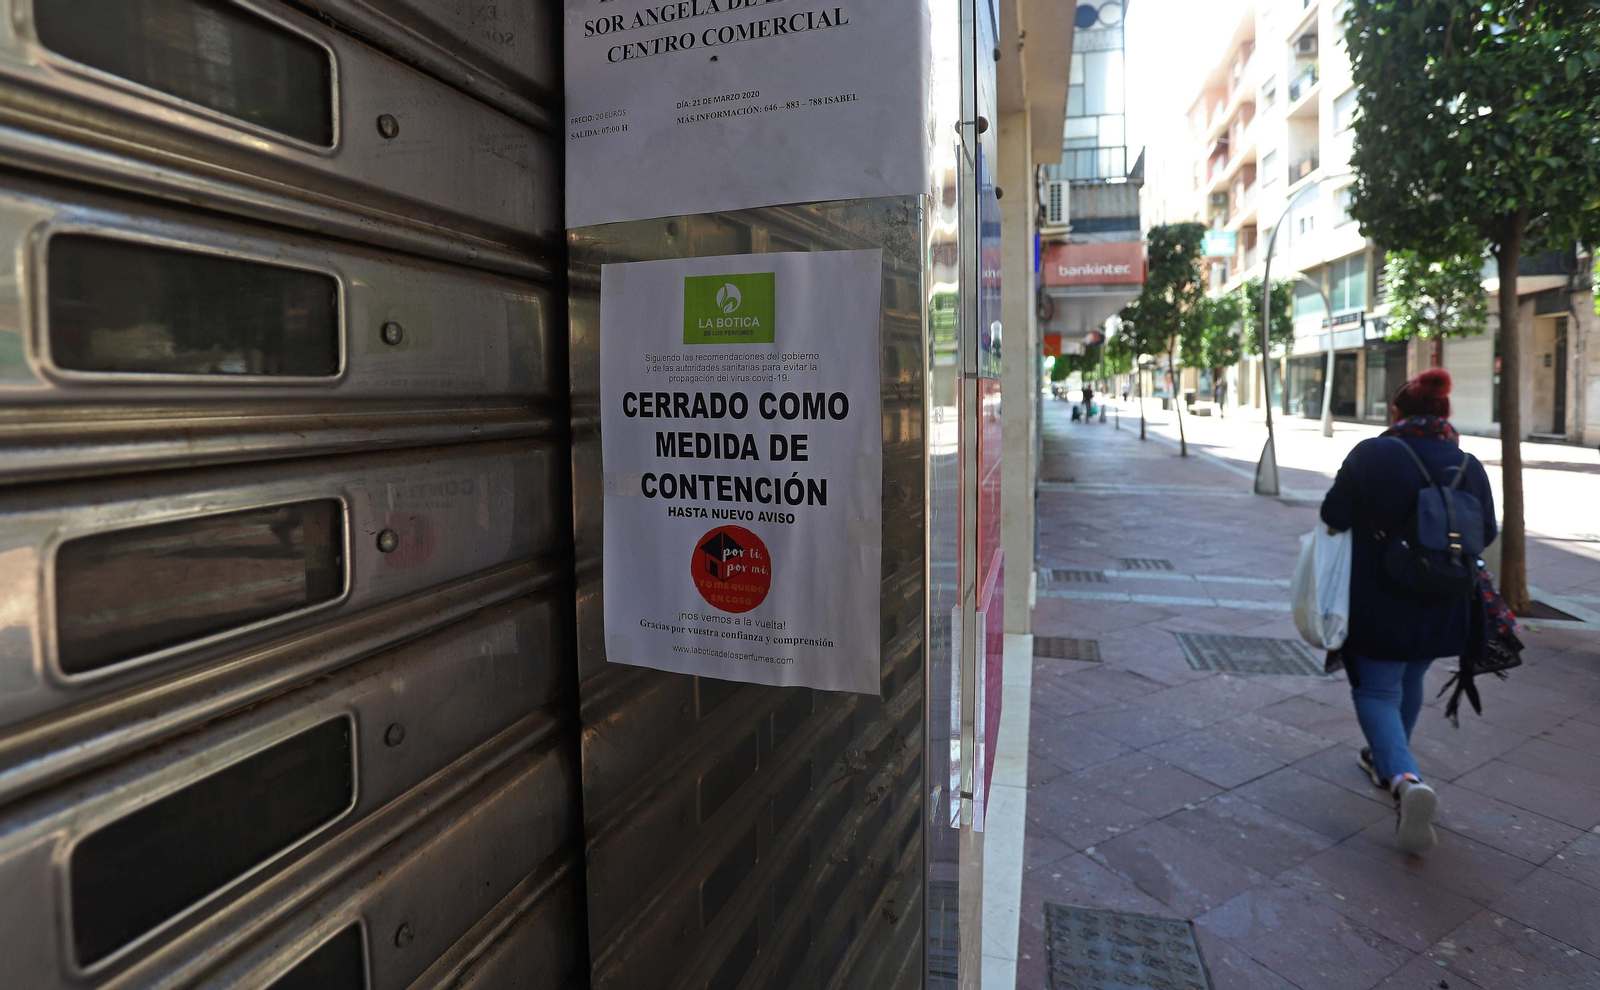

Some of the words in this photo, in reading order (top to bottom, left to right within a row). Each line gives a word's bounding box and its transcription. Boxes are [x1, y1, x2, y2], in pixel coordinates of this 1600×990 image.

[584, 15, 625, 38] SOR
[631, 0, 720, 28] ANGELA
[607, 32, 696, 63] CENTRO
[701, 7, 849, 47] COMERCIAL
[676, 100, 691, 109] DÍA:
[692, 99, 701, 107] 21
[702, 97, 712, 105] DE
[713, 93, 740, 103] MARZO
[742, 90, 760, 99] 2020
[676, 114, 695, 124] MÁS
[696, 105, 762, 122] INFORMACIÓN:
[764, 104, 778, 112] 646
[786, 101, 800, 109] 883
[808, 98, 822, 106] 788
[824, 93, 859, 105] ISABEL
[571, 115, 595, 125] PRECIO:
[596, 112, 604, 120] 20
[605, 109, 627, 119] EUROS
[571, 129, 600, 140] SALIDA:
[602, 125, 620, 134] 07:00
[622, 124, 629, 132] H
[698, 319, 713, 329] LA
[716, 316, 760, 328] BOTICA
[645, 354, 681, 364] Siguiendo
[682, 354, 694, 362] las
[695, 353, 765, 361] recomendaciones
[767, 352, 780, 360] del
[781, 352, 820, 362] gobierno
[652, 364, 662, 372] de
[663, 364, 674, 372] las
[675, 363, 720, 372] autoridades
[721, 363, 760, 371] sanitarias
[762, 364, 781, 372] para
[783, 362, 808, 371] evitar
[809, 362, 818, 371] la
[668, 374, 714, 383] propagación
[717, 374, 729, 382] del
[730, 374, 750, 382] virus
[751, 373, 790, 382] covid-19.
[622, 391, 749, 420] CERRADO
[759, 391, 850, 421] COMO
[655, 431, 760, 461] MEDIDA
[769, 434, 809, 462] DE
[641, 471, 828, 506] CONTENCIÓN
[668, 506, 708, 519] HASTA
[711, 508, 754, 521] NUEVO
[757, 511, 796, 524] AVISO
[723, 548, 745, 563] por
[727, 563, 748, 577] por
[699, 579, 713, 588] YO
[711, 594, 724, 602] EN
[701, 615, 732, 625] vemos
[743, 617, 752, 626] la
[754, 619, 786, 630] vuelta!
[640, 618, 670, 631] Gracias
[671, 626, 686, 634] por
[688, 628, 719, 637] vuestra
[721, 630, 763, 642] confianza
[765, 636, 771, 644] y
[773, 636, 835, 648] comprensión
[672, 645, 794, 665] www.laboticadelosperfumes.com
